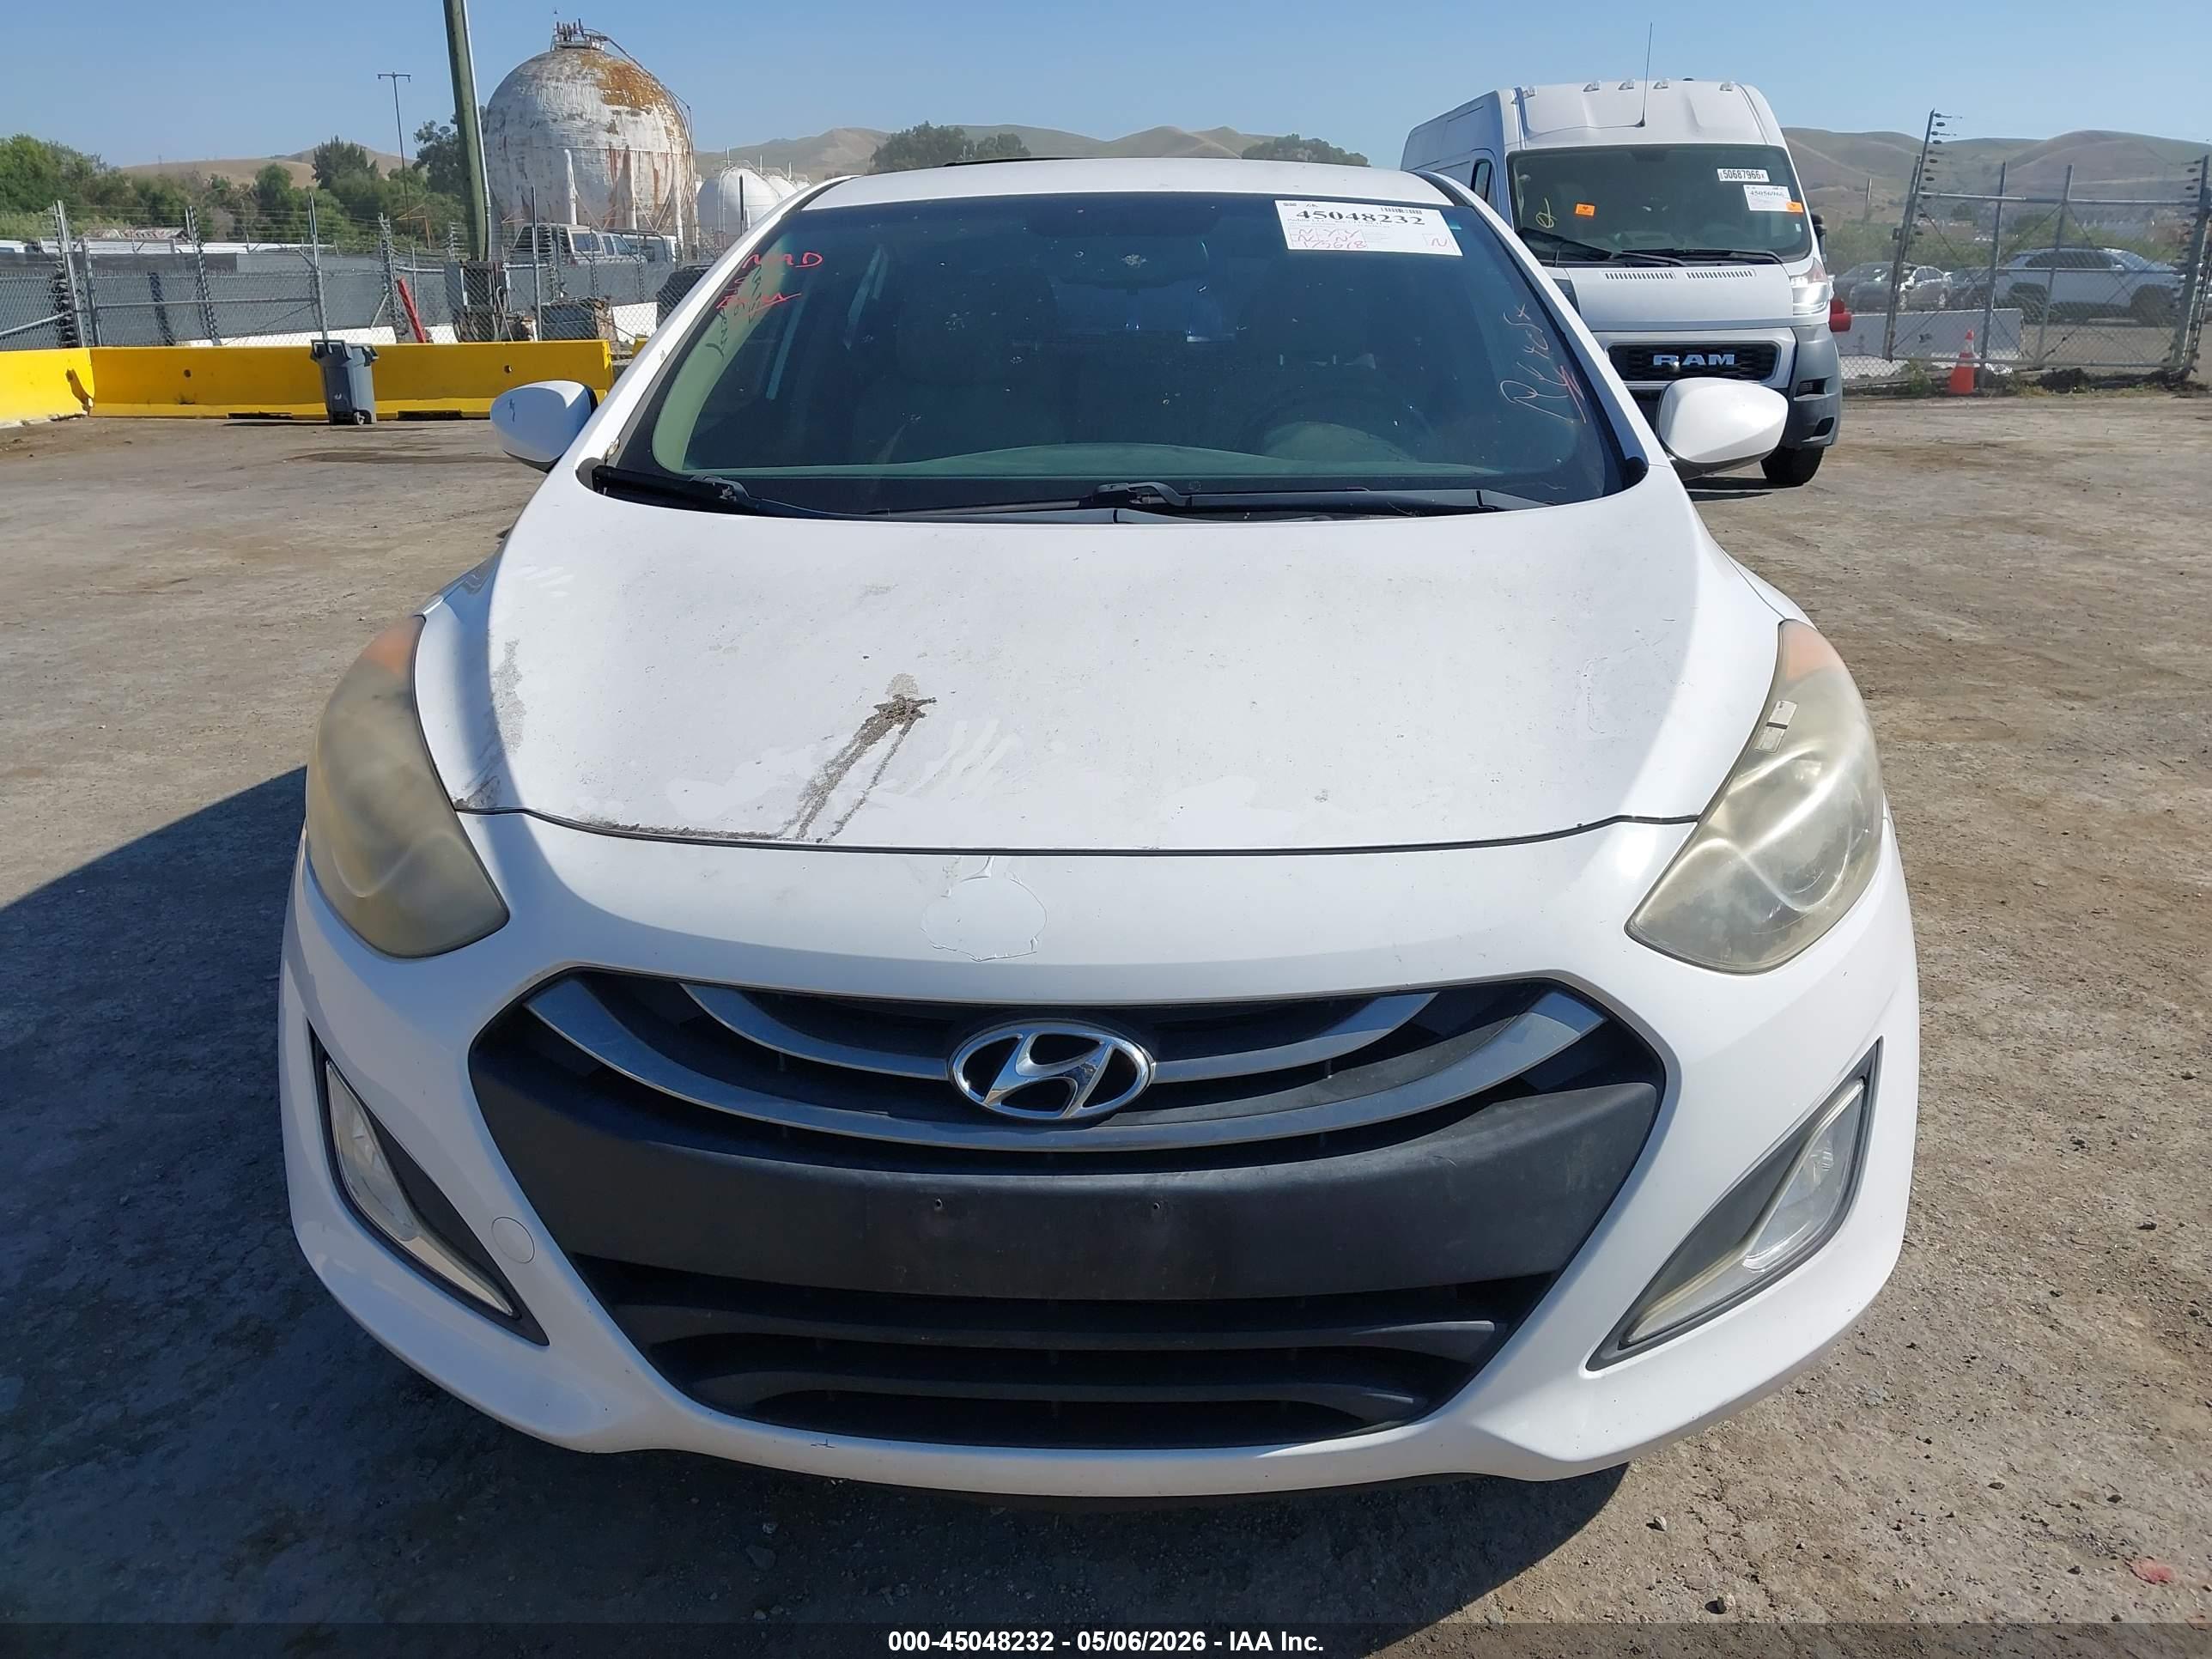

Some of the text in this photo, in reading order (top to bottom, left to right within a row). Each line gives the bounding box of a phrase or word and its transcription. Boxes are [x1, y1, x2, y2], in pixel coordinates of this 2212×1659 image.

[1723, 170, 1761, 179] 50687966
[1296, 210, 1425, 225] 45048232
[1653, 354, 1735, 367] RAM
